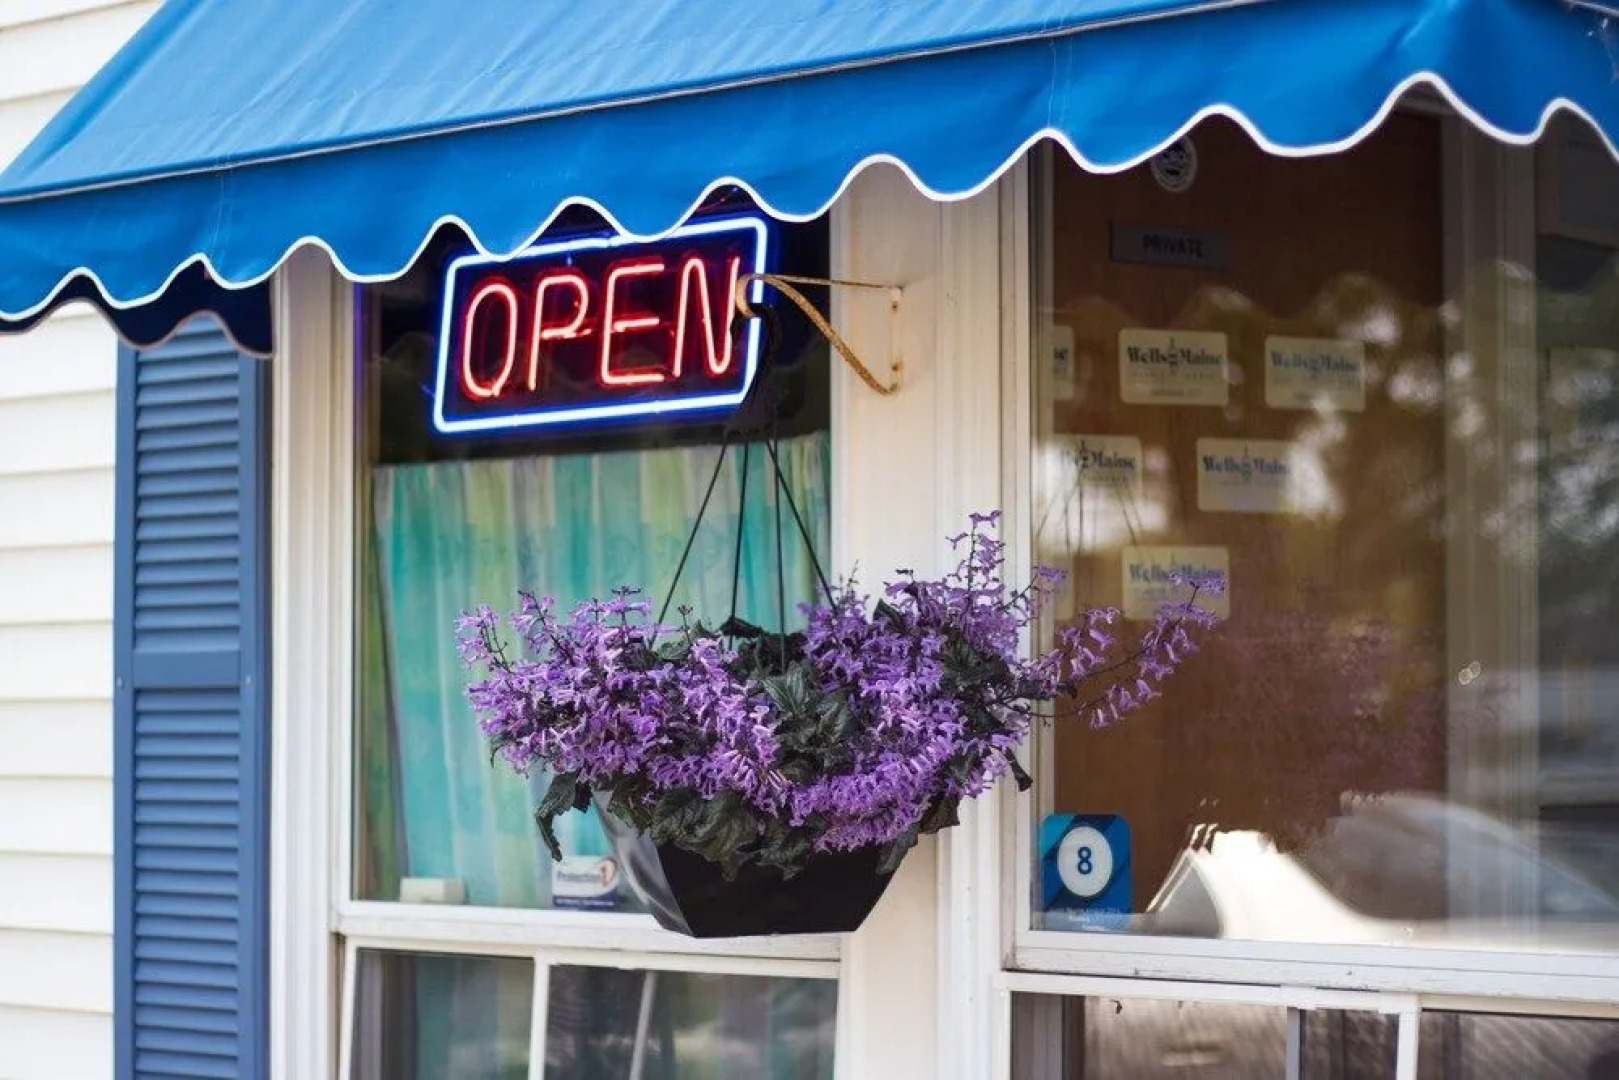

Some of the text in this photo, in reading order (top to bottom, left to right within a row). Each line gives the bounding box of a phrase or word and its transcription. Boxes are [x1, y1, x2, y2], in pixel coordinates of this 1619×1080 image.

[1142, 233, 1204, 259] PRIVATE
[462, 256, 741, 398] OPEN
[1127, 345, 1167, 364] Wells
[1077, 846, 1092, 875] 8
